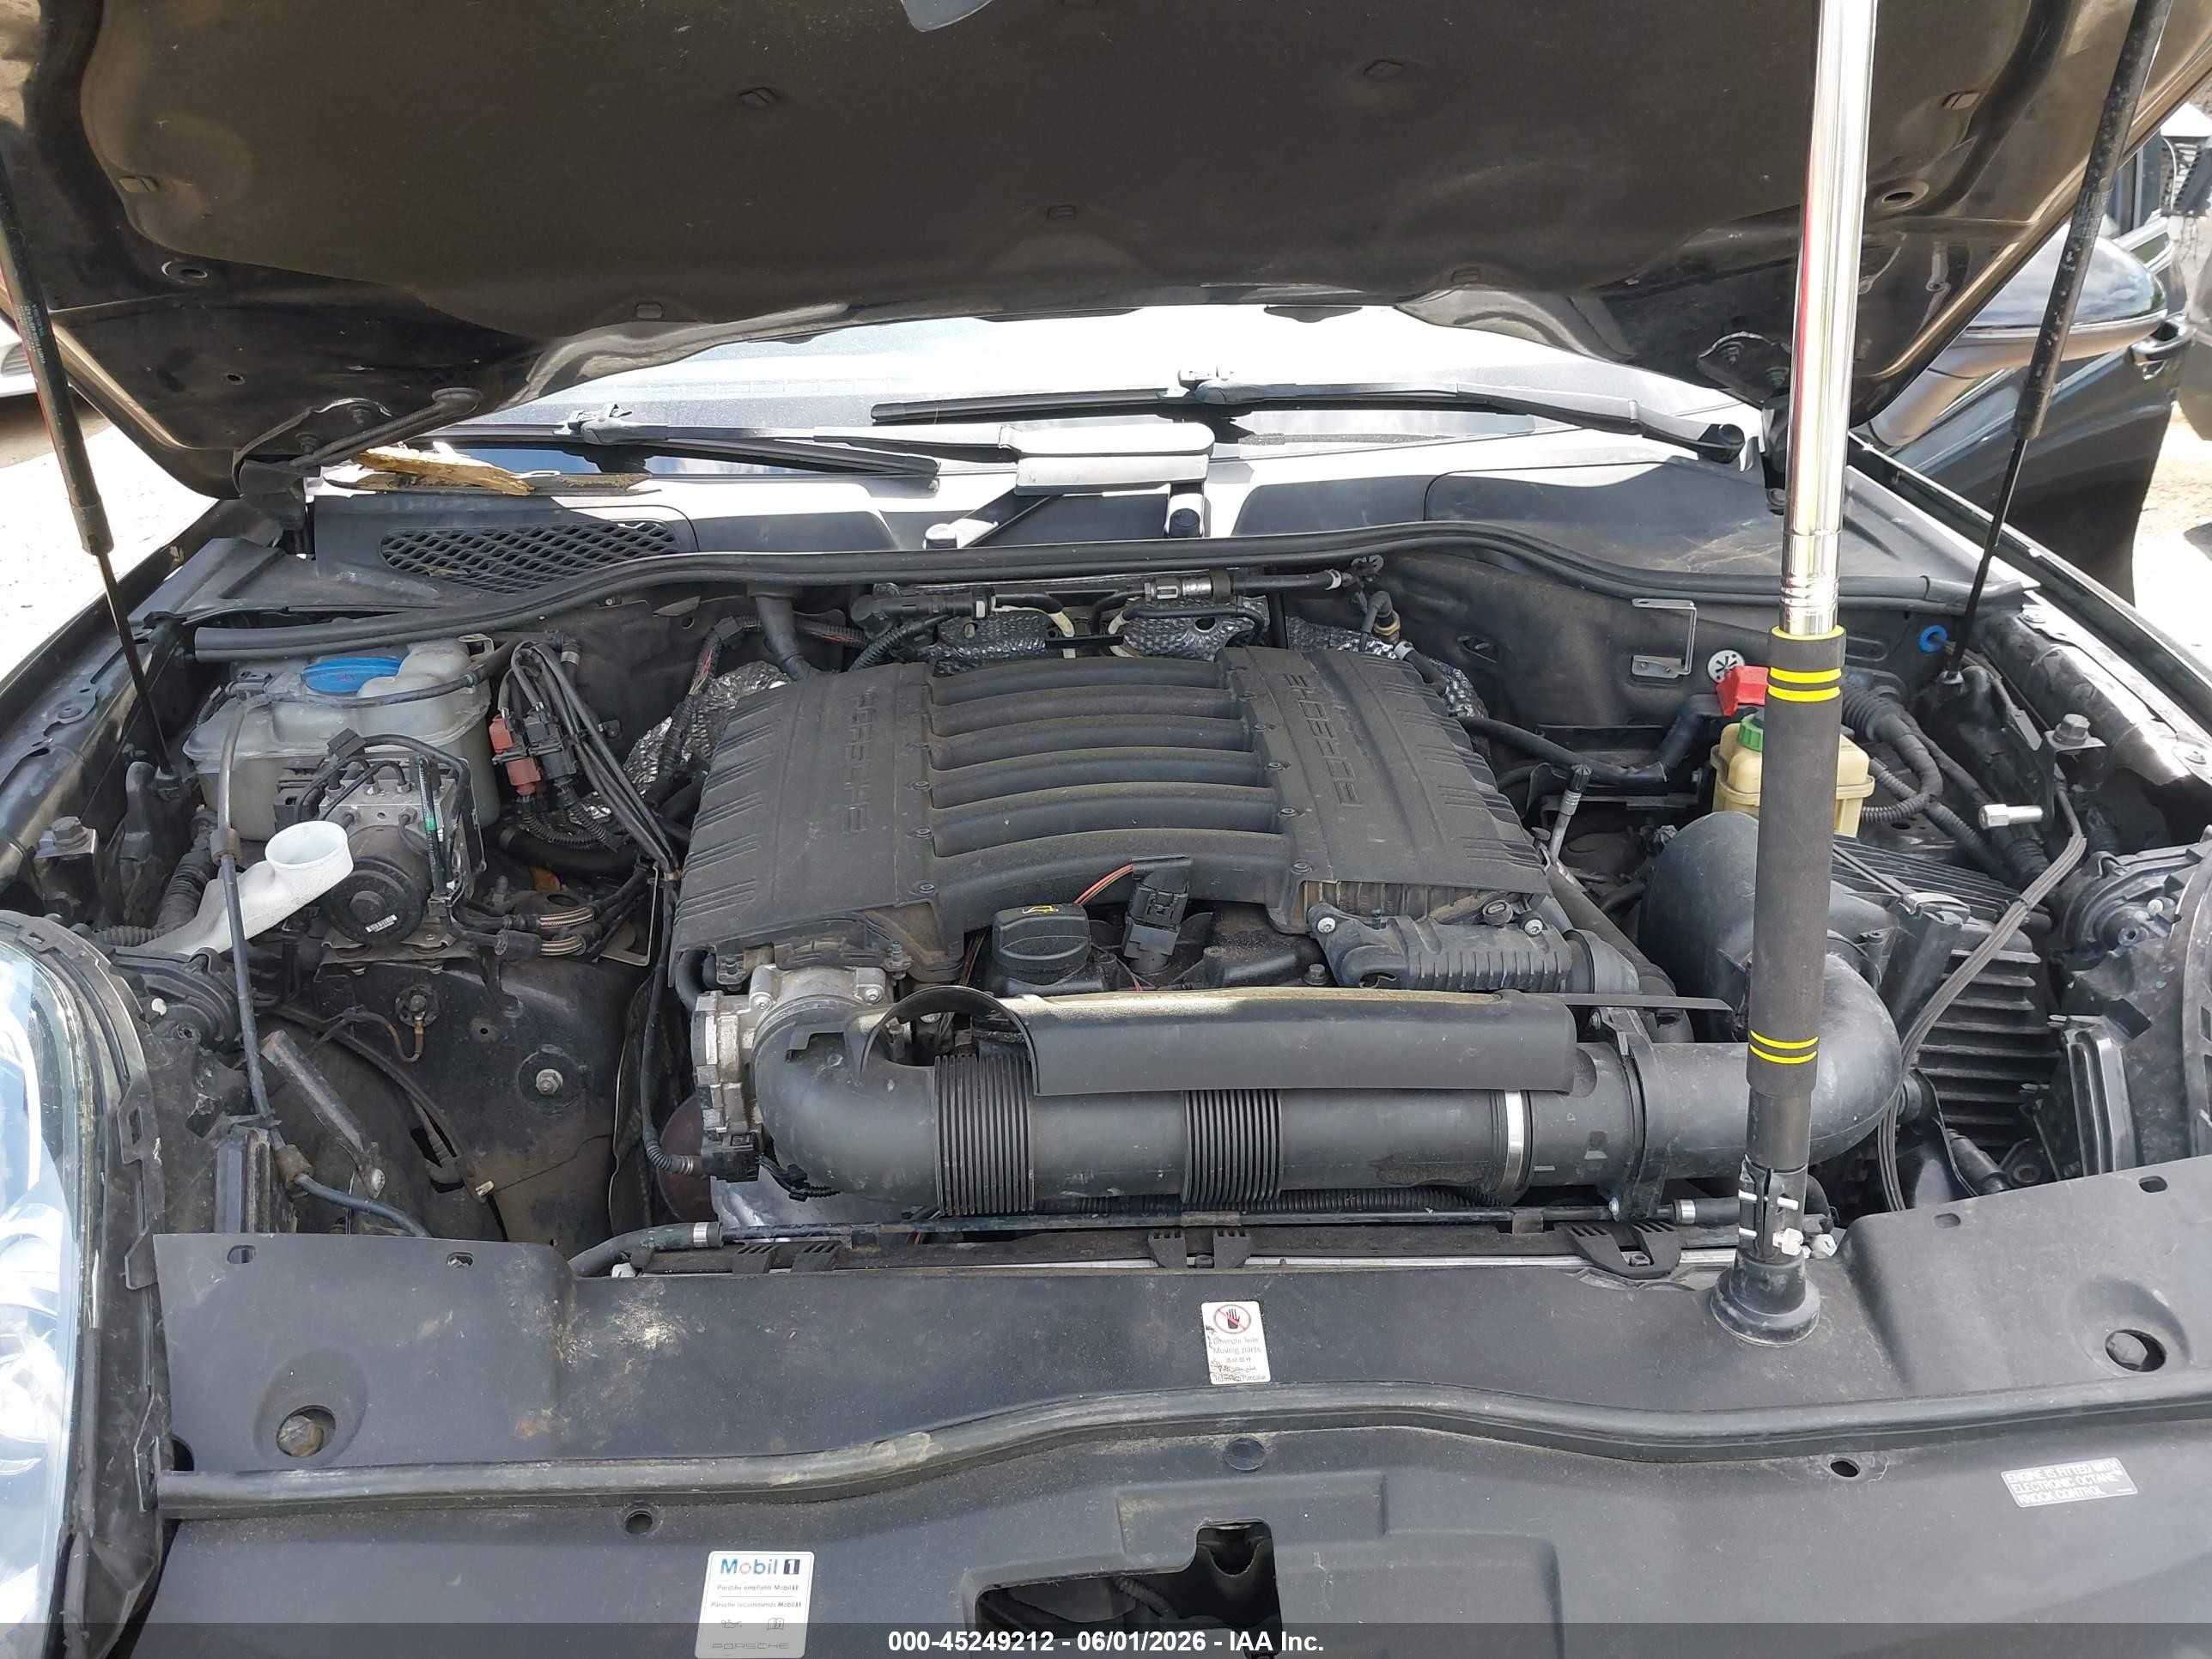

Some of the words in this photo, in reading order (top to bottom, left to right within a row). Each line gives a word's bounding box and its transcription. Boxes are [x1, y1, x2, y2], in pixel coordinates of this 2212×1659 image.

[1212, 1346, 1240, 1355] Moving
[1242, 1346, 1261, 1354] parts
[2005, 1471, 2045, 1483] ENGINE
[2045, 1469, 2057, 1478] IS
[2057, 1464, 2093, 1477] FITTED
[2092, 1461, 2120, 1473] WITH
[2010, 1477, 2075, 1493] ELECTRONIC
[2075, 1470, 2120, 1486] OCTANE
[2016, 1490, 2057, 1504] KNOCK
[2055, 1485, 2106, 1499] CONTROL
[720, 1559, 778, 1575] Mobil
